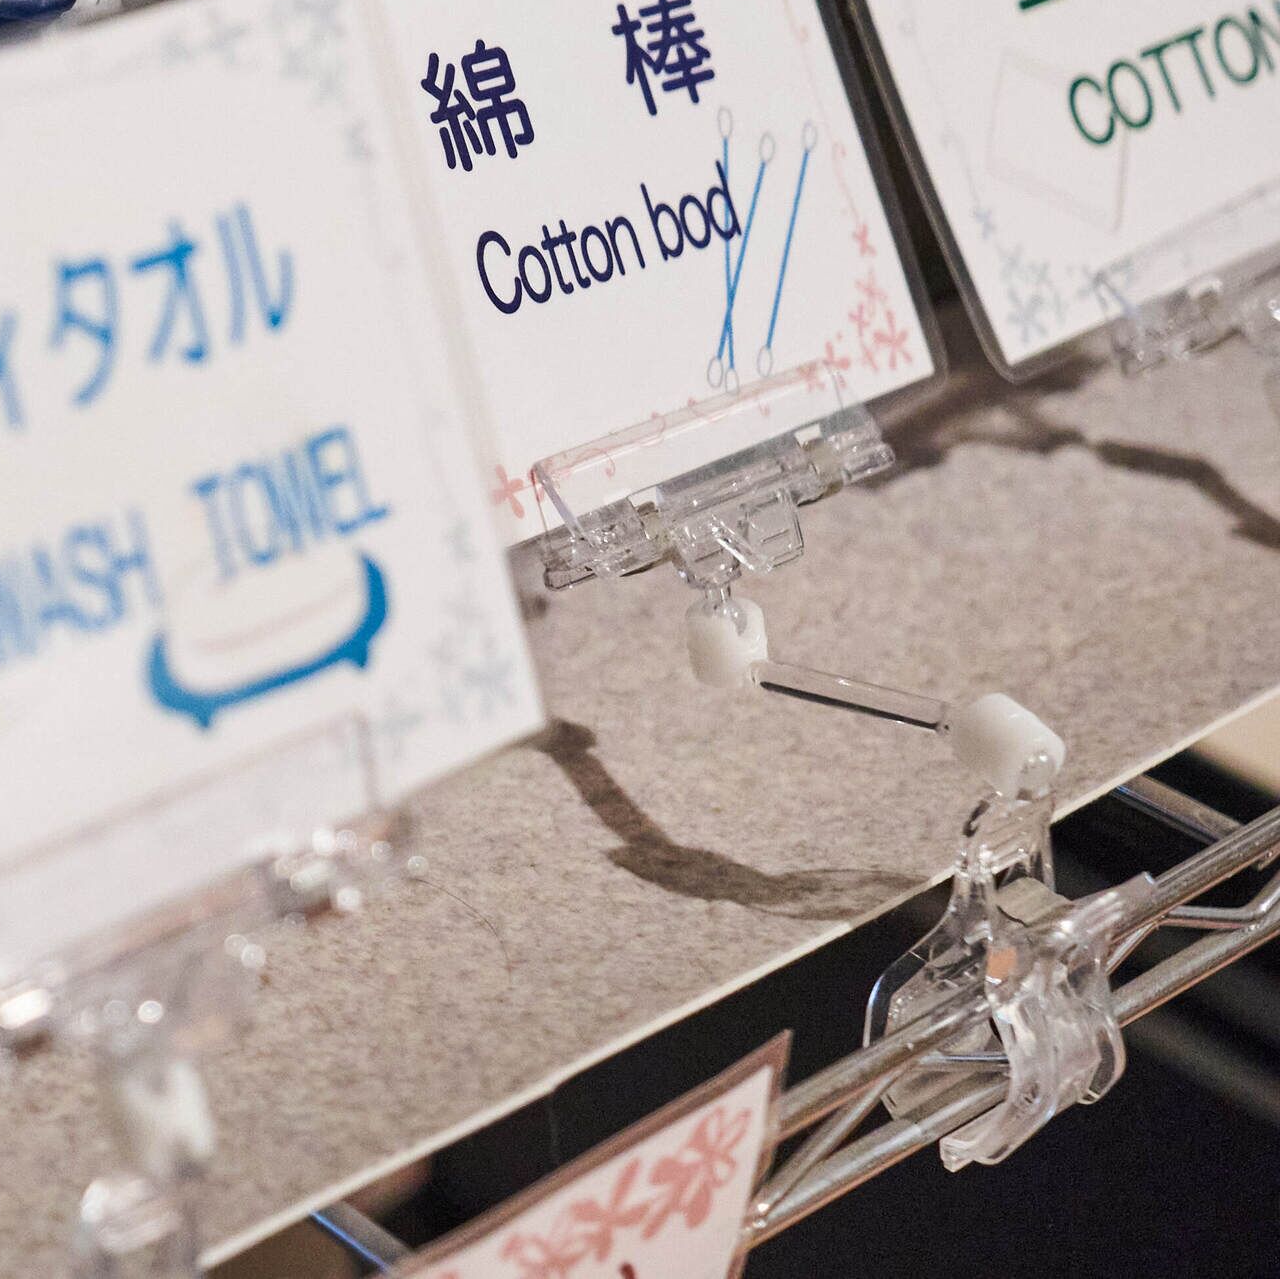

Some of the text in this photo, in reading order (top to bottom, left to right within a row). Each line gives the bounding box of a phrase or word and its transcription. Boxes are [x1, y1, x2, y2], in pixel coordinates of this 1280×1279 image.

[475, 160, 742, 315] Cotton bod
[187, 423, 393, 582] TOWEL
